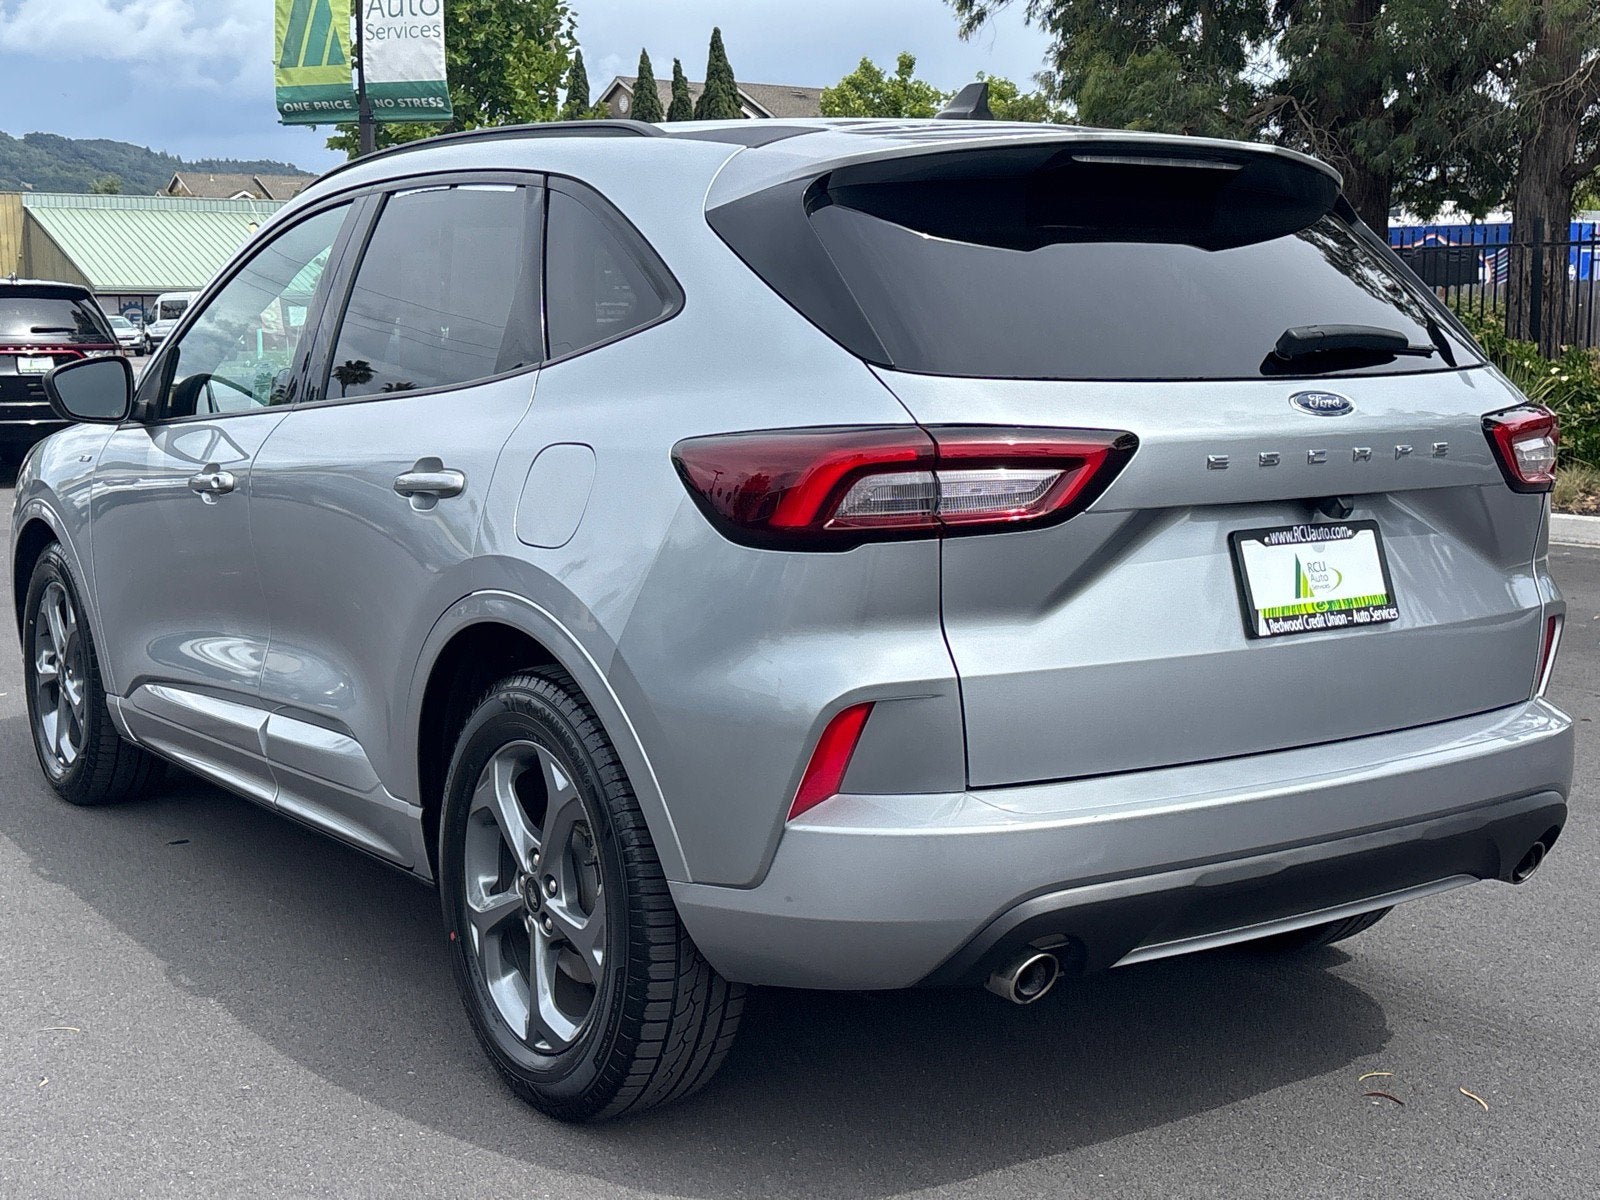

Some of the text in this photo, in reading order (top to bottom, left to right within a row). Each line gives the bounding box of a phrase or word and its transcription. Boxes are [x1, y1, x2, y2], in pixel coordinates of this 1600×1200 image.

[364, 22, 442, 41] Services
[283, 100, 352, 113] ONE PRICE
[374, 96, 445, 108] NO STRESS
[1307, 393, 1344, 409] Ford
[1206, 441, 1449, 470] ESCAPE
[1269, 525, 1349, 544] www.RCUauto.com
[1307, 561, 1327, 573] RCU
[1310, 573, 1329, 583] Auto
[1269, 616, 1303, 633] Redwood
[1304, 613, 1325, 630] Credit
[1326, 610, 1347, 627] Union
[1353, 609, 1370, 623] Auto
[1370, 606, 1399, 621] Services
